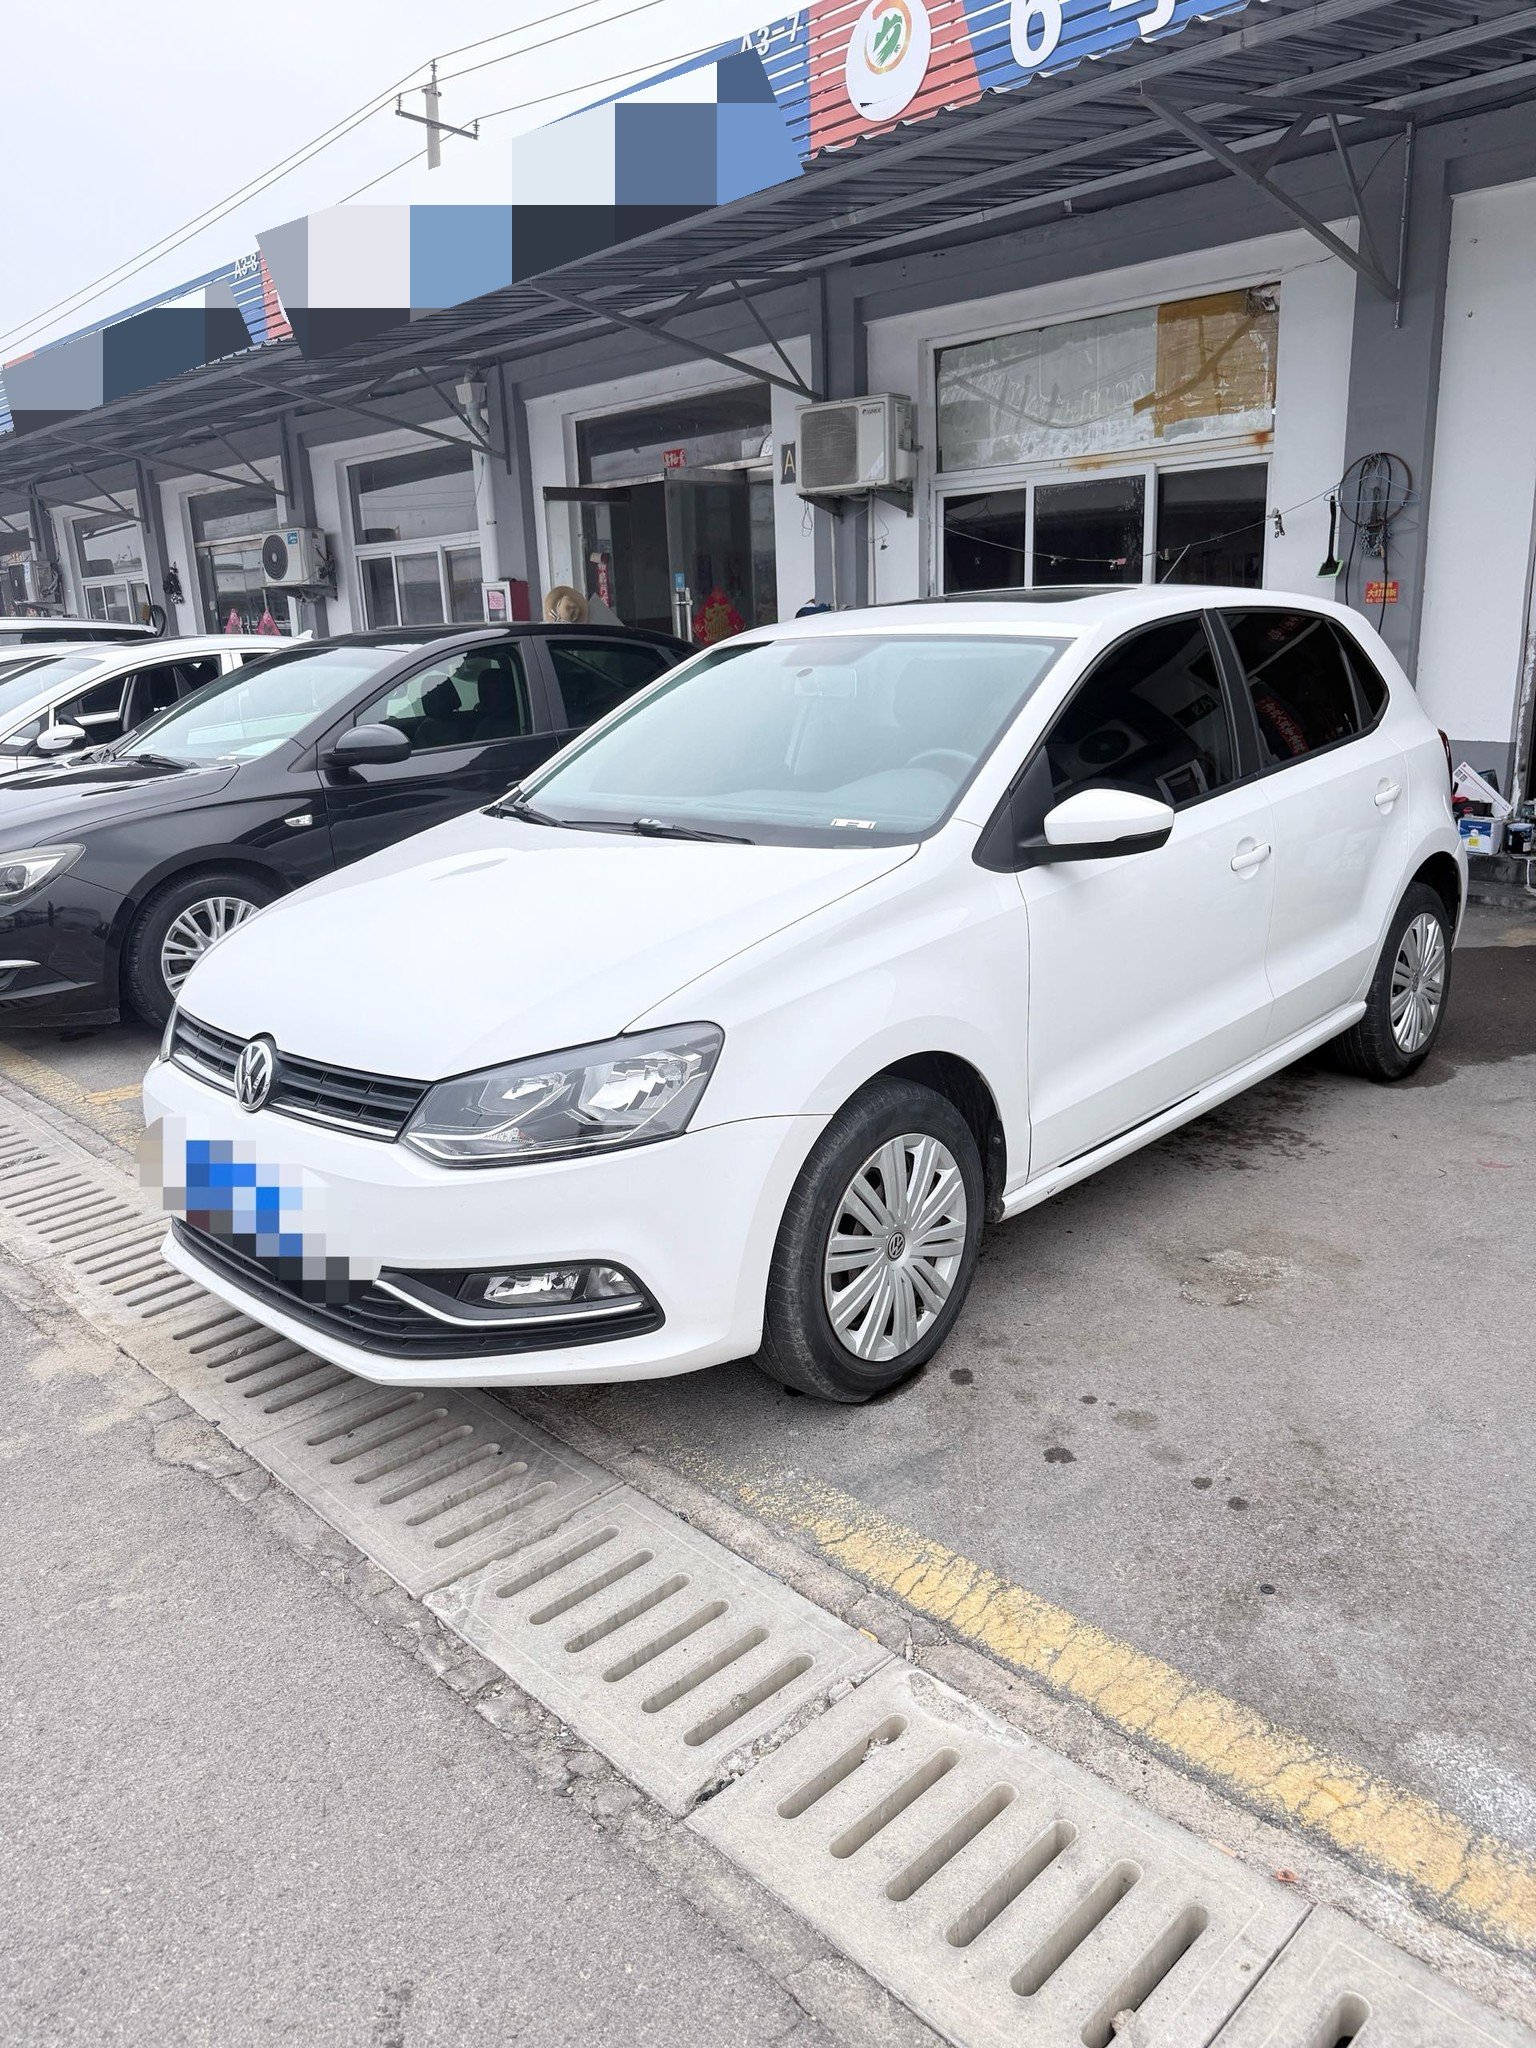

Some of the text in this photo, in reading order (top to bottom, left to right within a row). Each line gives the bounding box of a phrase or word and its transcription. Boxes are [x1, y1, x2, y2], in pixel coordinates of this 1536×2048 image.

[234, 253, 258, 279] A3-8
[784, 449, 796, 475] A
[235, 1041, 272, 1111] VW
